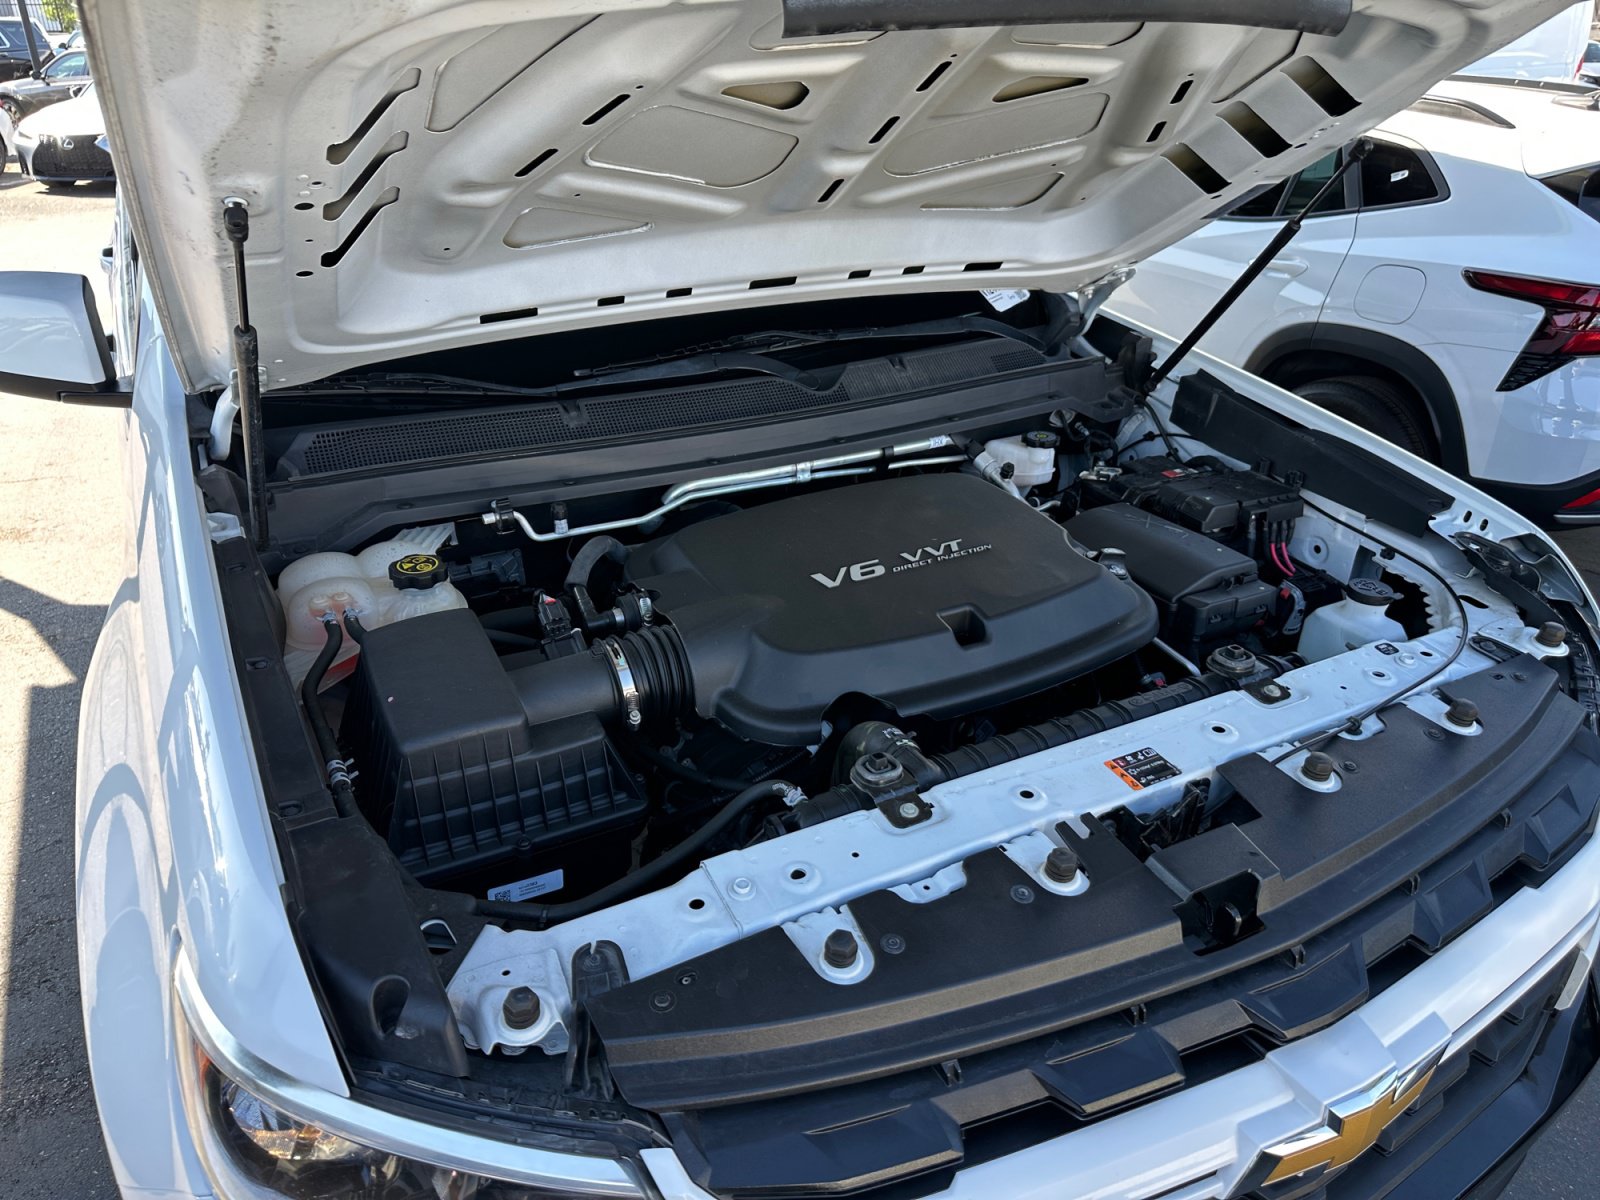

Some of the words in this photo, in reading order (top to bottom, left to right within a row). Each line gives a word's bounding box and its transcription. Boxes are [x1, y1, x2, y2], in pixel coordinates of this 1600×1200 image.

[810, 559, 886, 589] V6
[900, 538, 963, 562] VVT
[892, 558, 933, 573] DIRECT
[937, 544, 992, 562] INJECTION
